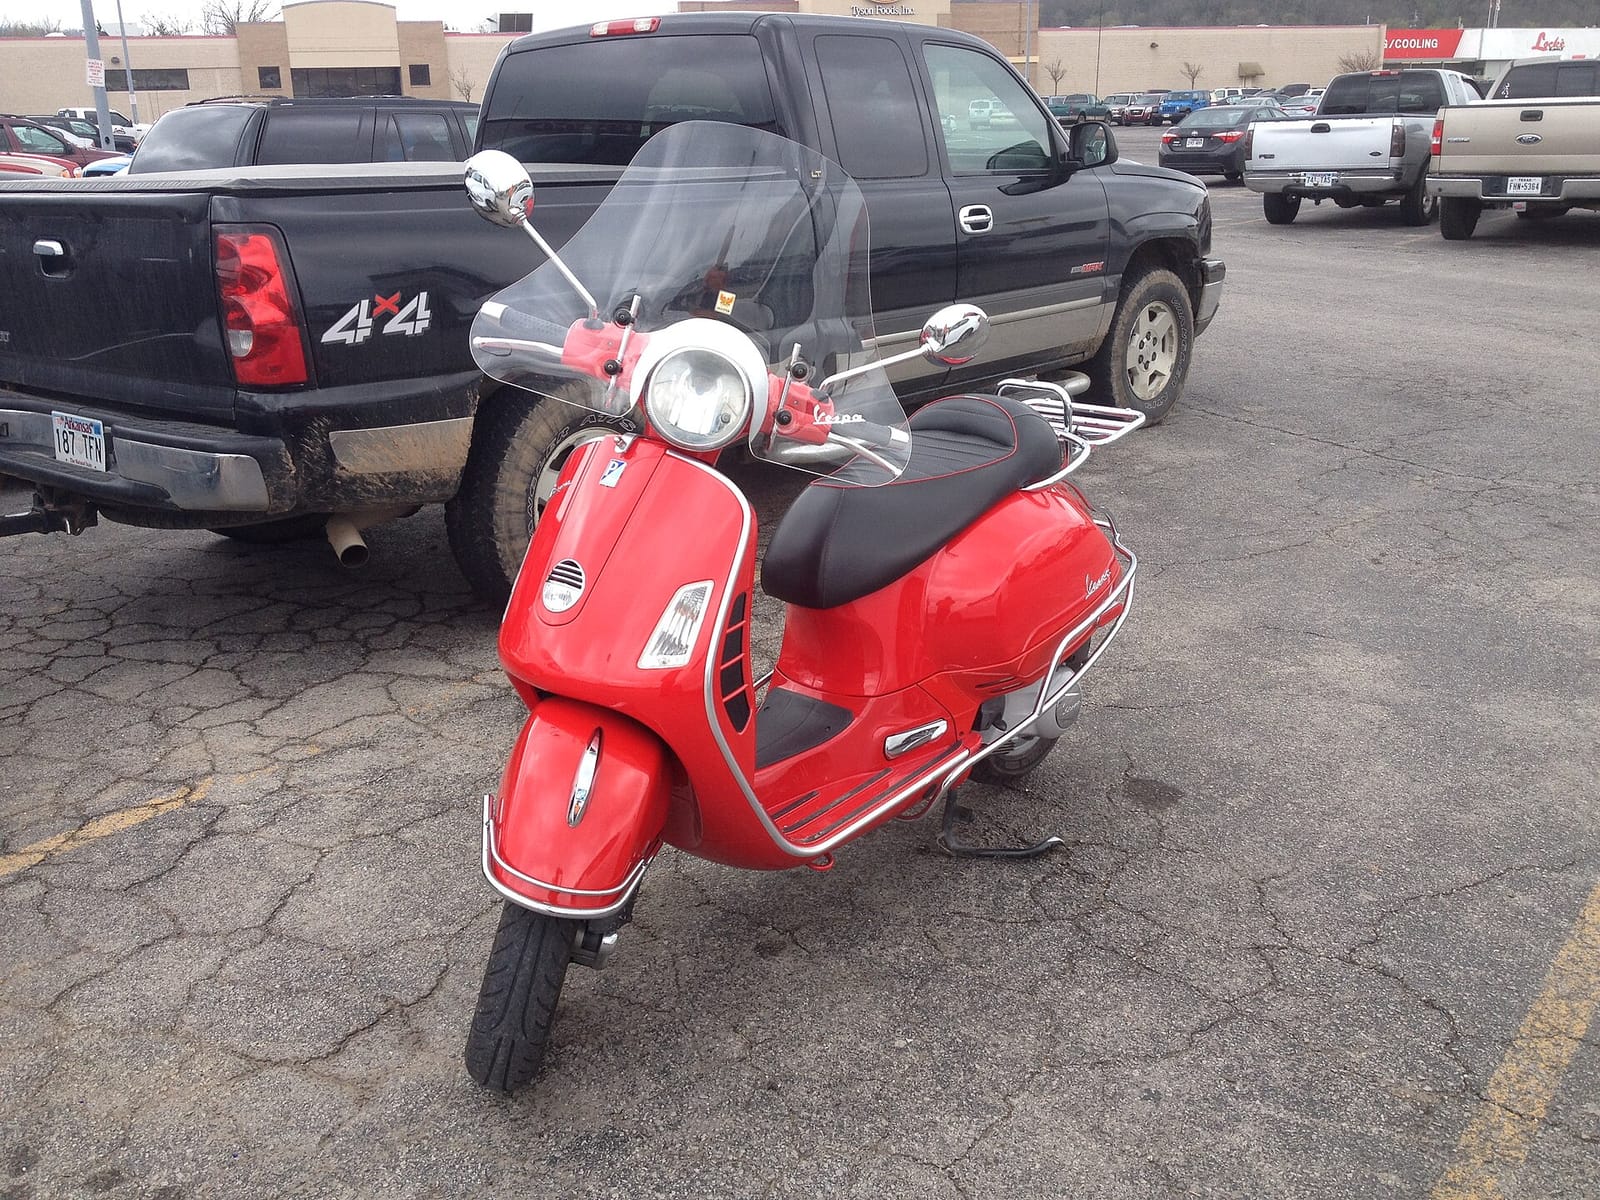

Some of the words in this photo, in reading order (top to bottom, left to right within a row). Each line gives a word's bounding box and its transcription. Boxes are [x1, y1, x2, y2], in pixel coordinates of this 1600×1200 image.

[851, 5, 874, 17] Tyson
[811, 170, 822, 178] LT
[812, 404, 867, 425] Vespa
[64, 416, 94, 434] Arkansas
[56, 428, 75, 456] 187
[81, 433, 102, 464] TFN
